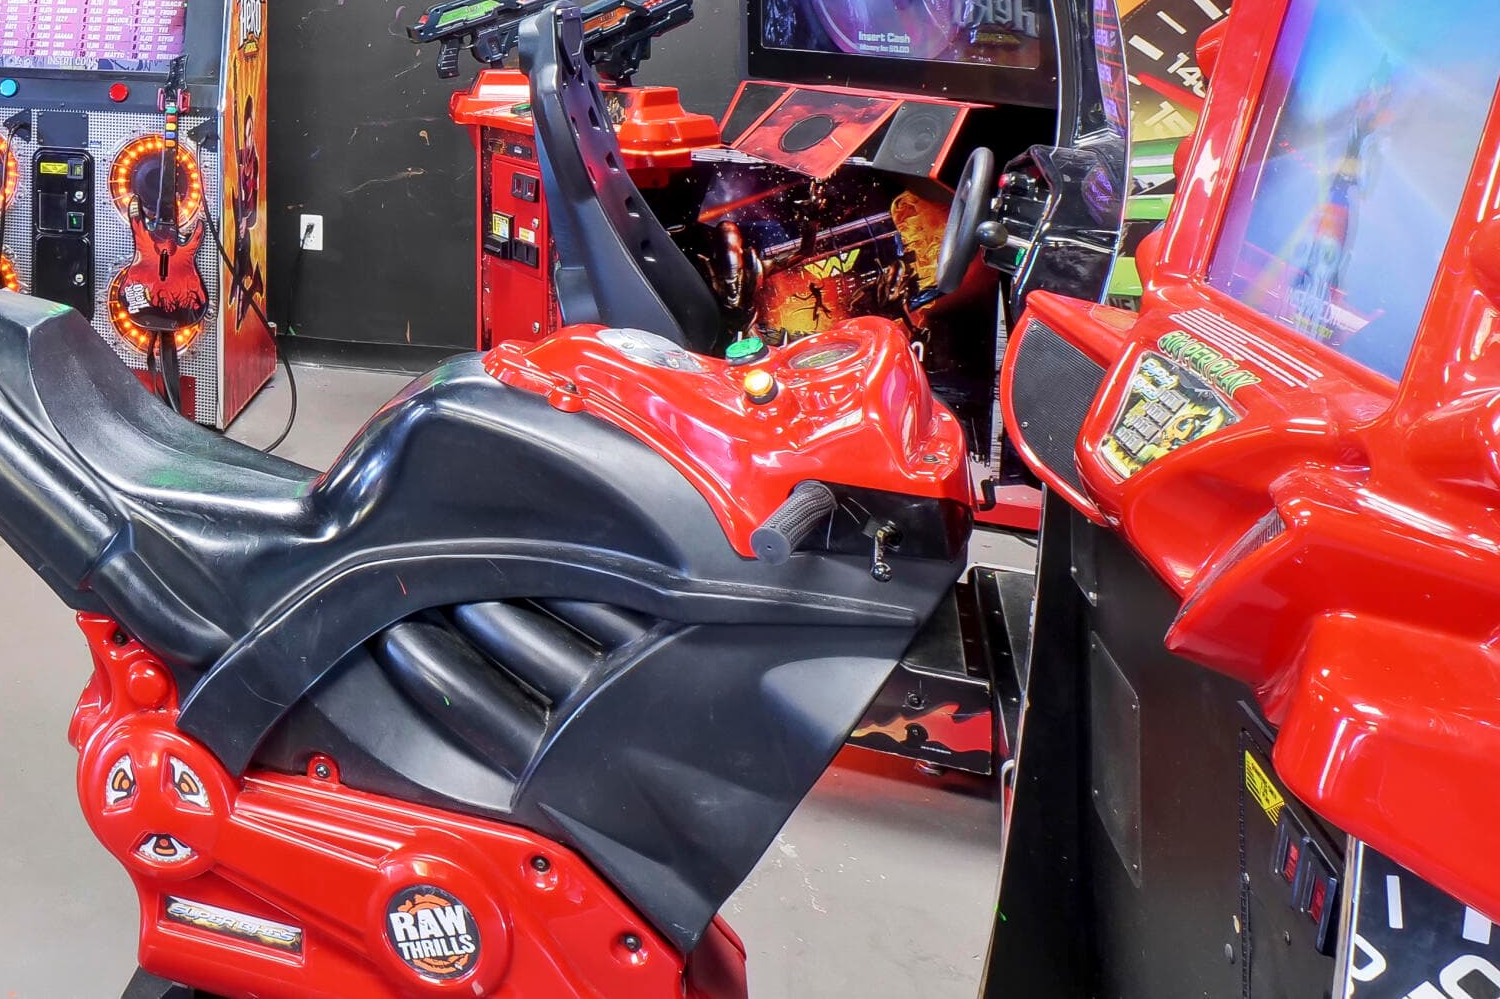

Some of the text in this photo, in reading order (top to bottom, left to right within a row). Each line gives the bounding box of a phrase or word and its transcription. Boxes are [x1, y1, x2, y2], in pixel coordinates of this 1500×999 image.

[858, 31, 911, 44] Insert Cash
[1209, 358, 1262, 400] PLAY
[169, 901, 236, 930] SUPER
[389, 904, 468, 942] RAW
[397, 934, 477, 961] THRILLS
